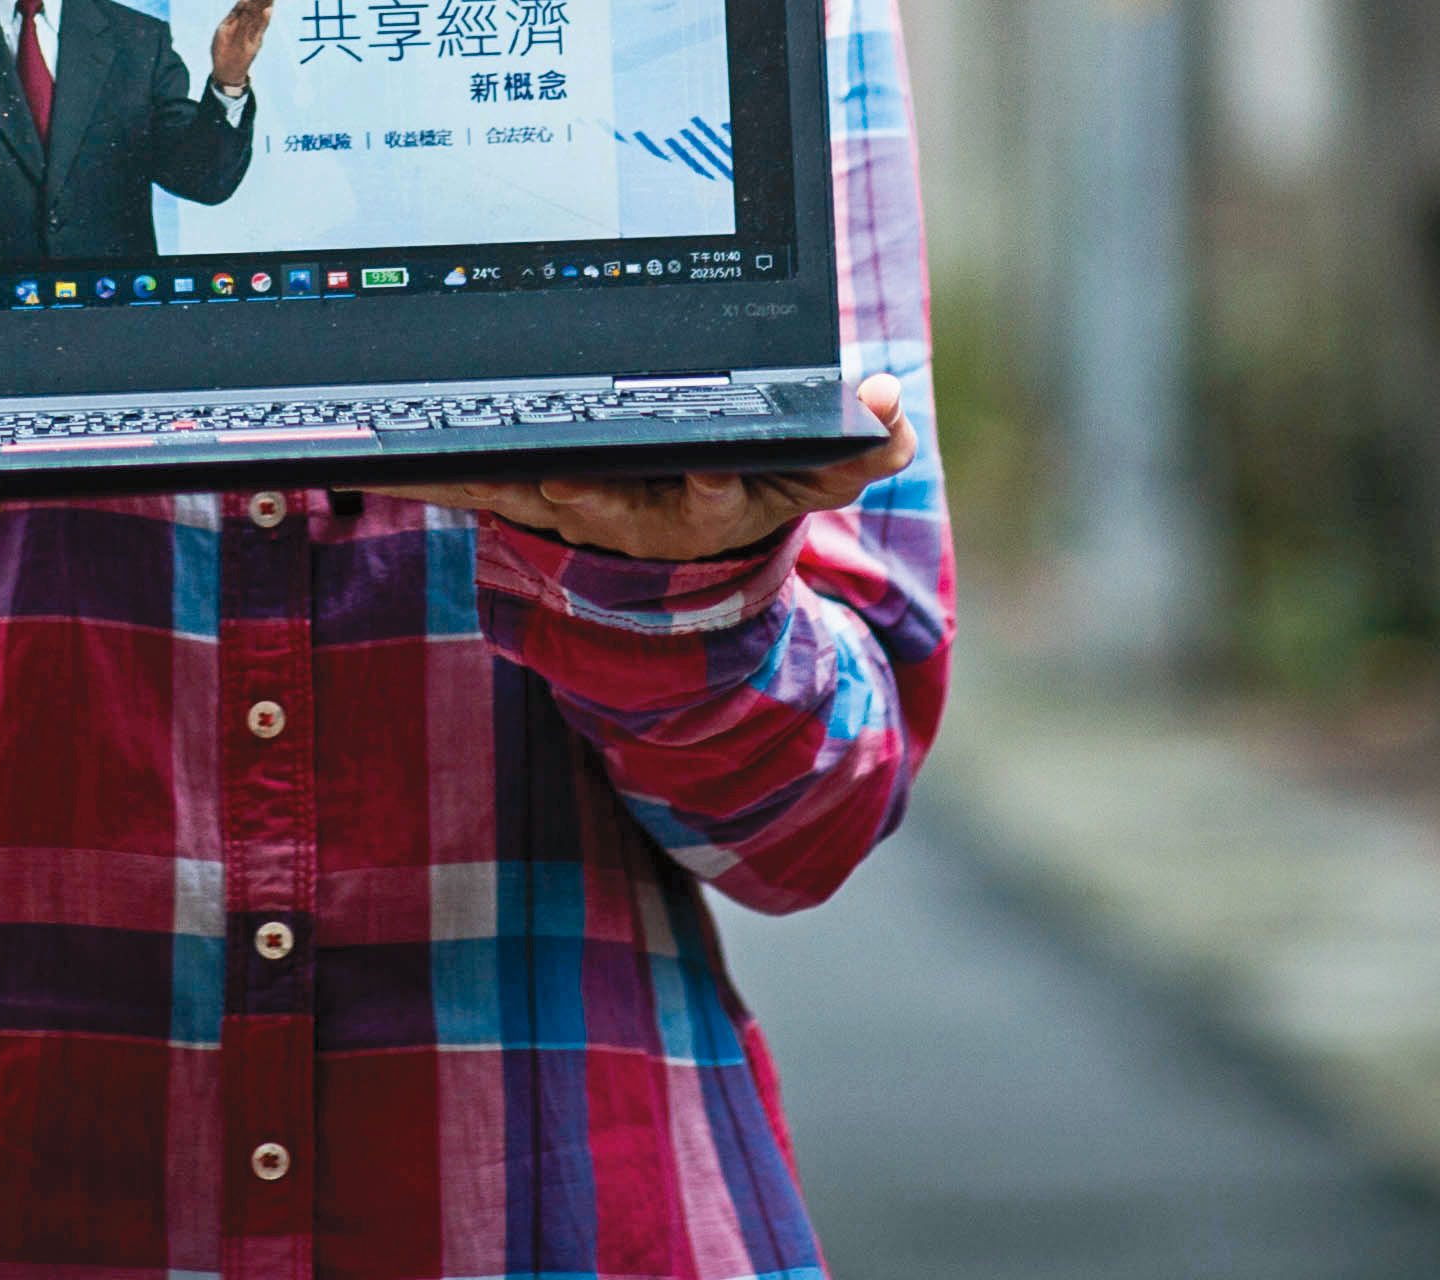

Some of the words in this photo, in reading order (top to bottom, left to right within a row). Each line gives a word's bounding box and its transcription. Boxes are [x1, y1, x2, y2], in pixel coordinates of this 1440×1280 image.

[470, 70, 567, 102] 新概念
[284, 133, 353, 153] 分散風險
[384, 129, 454, 149] 收益穩定
[486, 126, 554, 144] 合法安心
[714, 251, 741, 262] 01:40
[372, 271, 399, 283] 93%
[472, 267, 501, 281] 24°C
[690, 267, 741, 278] 2023/5/13
